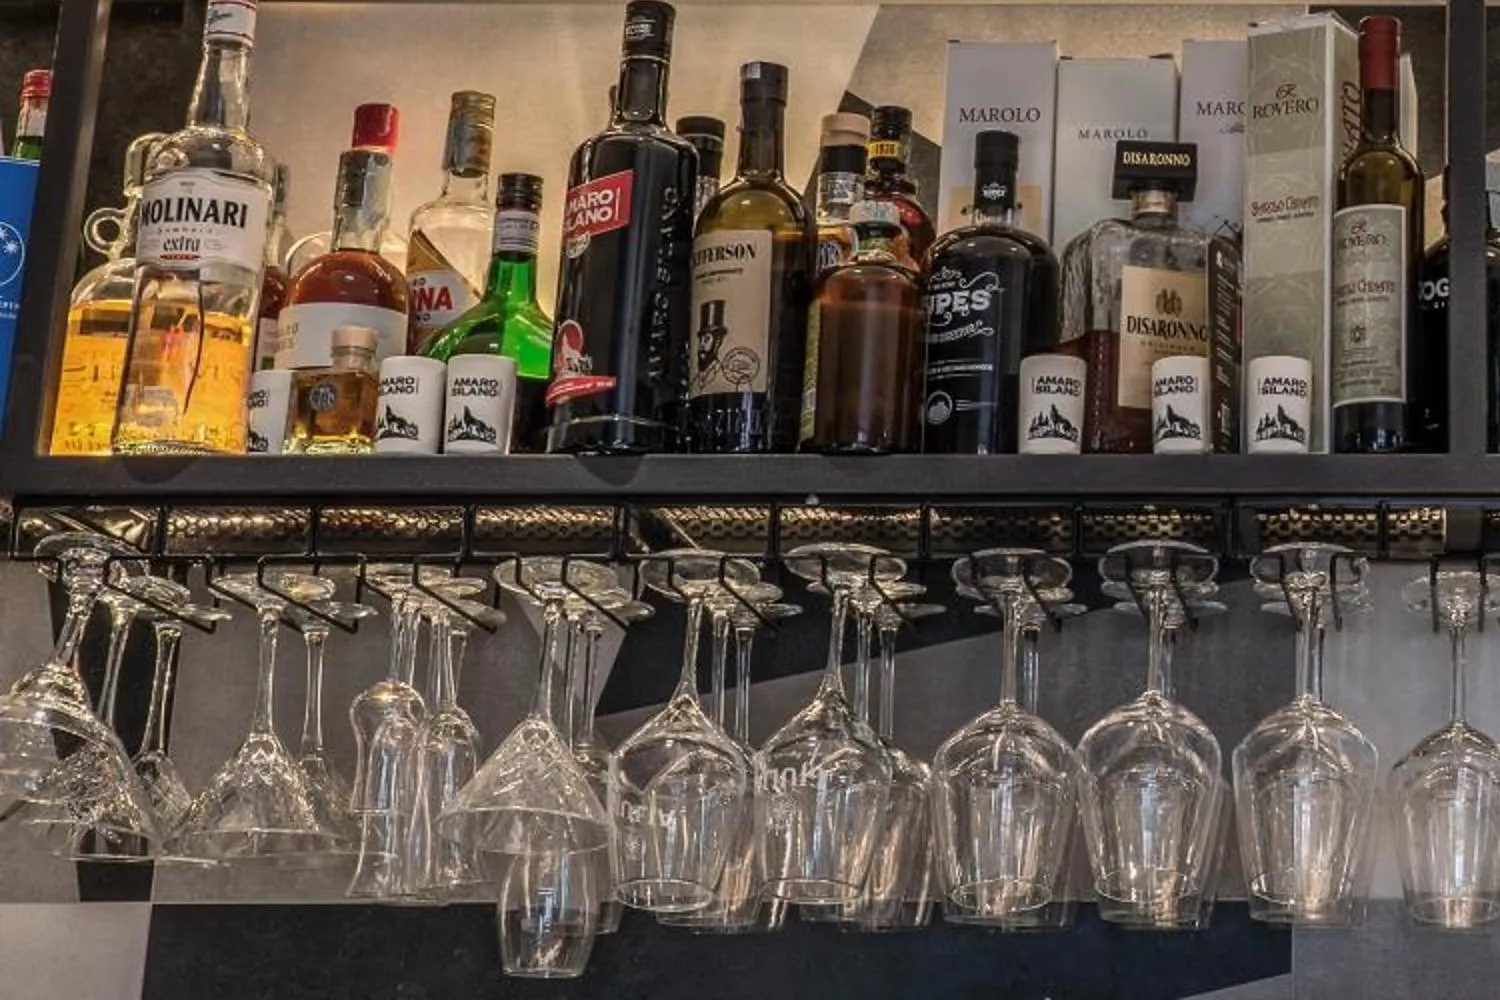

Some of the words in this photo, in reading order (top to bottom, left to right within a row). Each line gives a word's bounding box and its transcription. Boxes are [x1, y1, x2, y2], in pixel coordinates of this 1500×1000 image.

[958, 107, 1041, 124] MAROLO
[1196, 100, 1247, 117] MARO
[1252, 98, 1320, 119] ROVERO
[1077, 128, 1148, 140] MAROLO
[1123, 151, 1190, 167] DISARONNO
[567, 188, 614, 212] MARO
[141, 197, 248, 229] MOLINARI
[162, 235, 201, 253] extra
[411, 286, 454, 311] NA
[927, 289, 993, 316] UPES
[1127, 314, 1207, 342] DISARONNO
[379, 385, 415, 395] LANO
[453, 377, 499, 389] AMARO
[1036, 375, 1081, 389] AMARO
[1262, 376, 1307, 389] AMARO
[451, 387, 498, 398] SILANO
